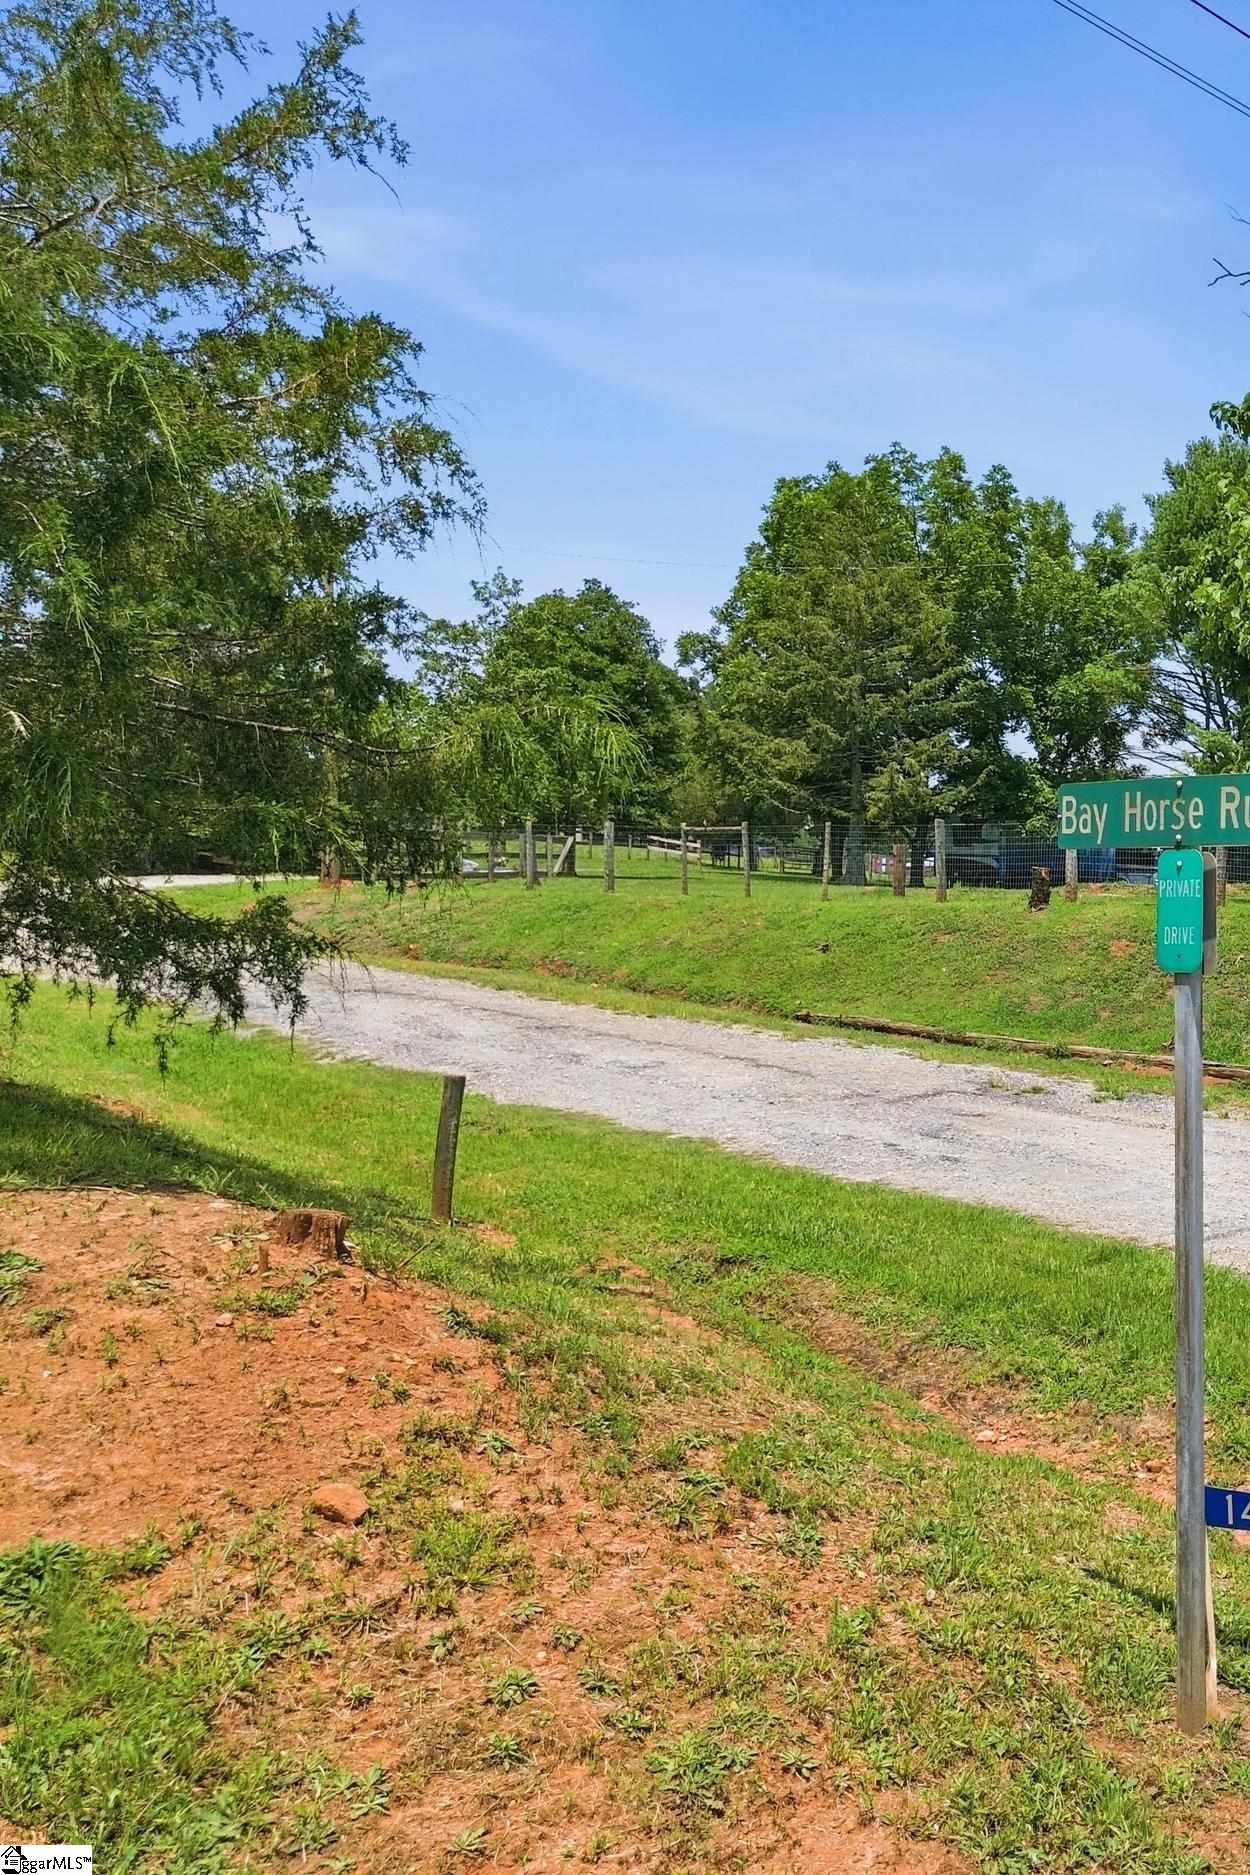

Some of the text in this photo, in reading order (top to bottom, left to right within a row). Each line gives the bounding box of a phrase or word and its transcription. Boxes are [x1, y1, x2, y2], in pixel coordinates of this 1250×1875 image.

[1061, 796, 1108, 844] Bay
[1124, 791, 1204, 832] Horse
[1159, 879, 1201, 898] PRIVATE
[1164, 926, 1195, 945] DRIVE
